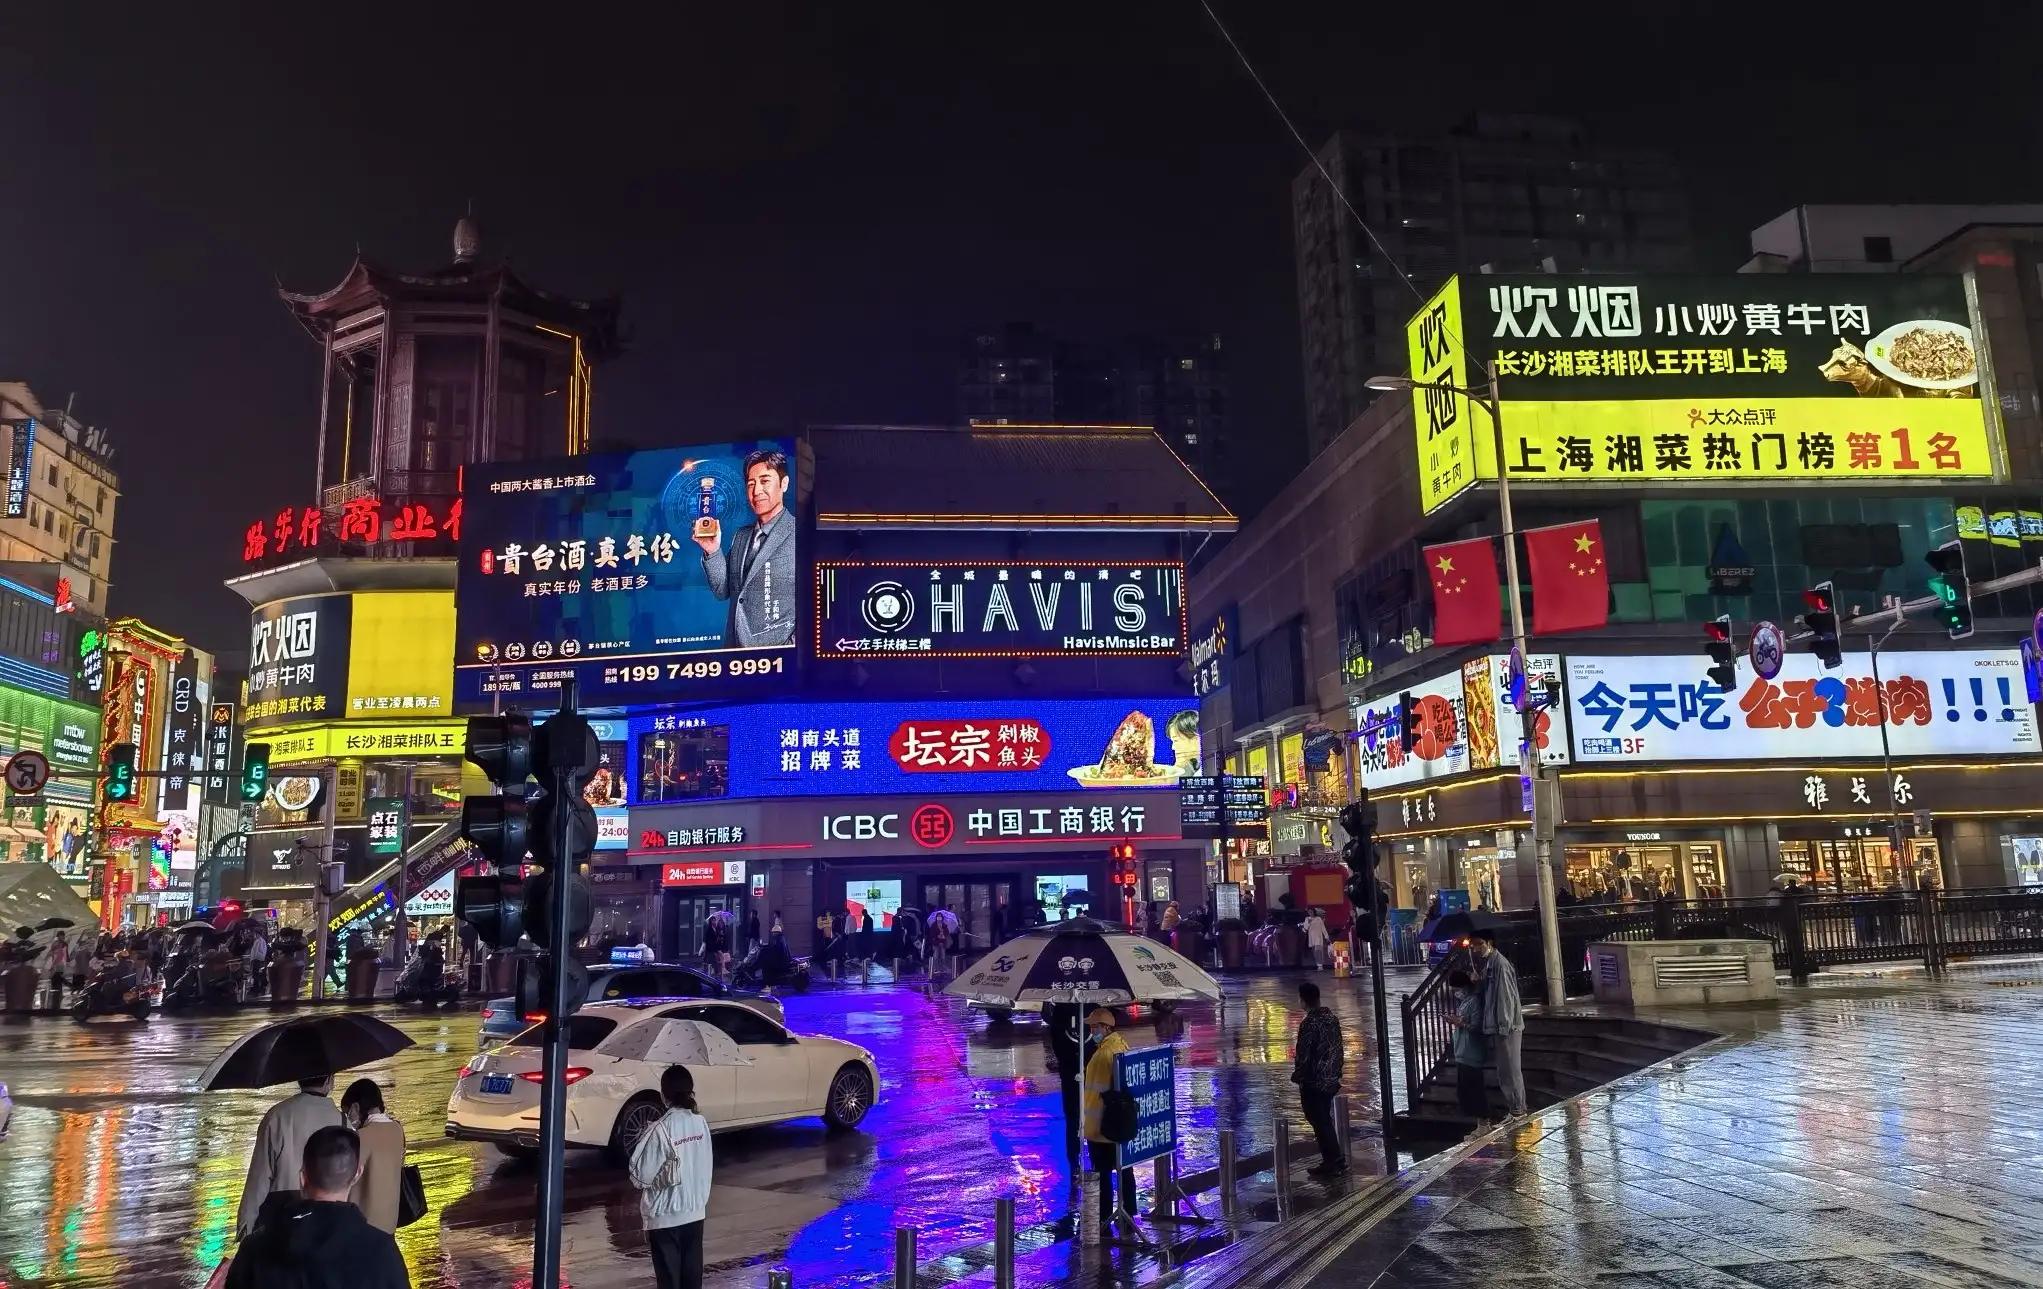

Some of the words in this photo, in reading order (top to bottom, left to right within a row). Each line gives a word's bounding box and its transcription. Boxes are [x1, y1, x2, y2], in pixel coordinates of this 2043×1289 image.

[1489, 285, 1642, 338] 炊烟
[1655, 302, 1872, 336] 小炒黄牛肉
[1495, 347, 1788, 377] 长沙湘菜排队王开到上海
[1707, 407, 1776, 426] 大众点评
[490, 474, 596, 494] 中国两大酱香上市酒企
[524, 580, 581, 597] 真实年份
[591, 575, 649, 592] 老酒更多
[931, 583, 1146, 632] HAVIS
[251, 611, 317, 668] 炊烟
[620, 666, 660, 683] 199
[667, 661, 722, 680] 7499
[729, 657, 784, 677] 9991
[176, 677, 191, 713] CRD
[353, 696, 441, 710] 营业至凌晨两点
[346, 732, 455, 749] 长沙湘菜排队王
[780, 728, 861, 748] 湖南头道
[997, 724, 1041, 744] 剁椒
[901, 724, 992, 767] 坛宗
[1623, 739, 1645, 754] 3F
[780, 749, 861, 772] 招牌菜
[1804, 775, 1913, 810] 雅戈尔
[370, 811, 399, 825] 点石
[823, 814, 899, 841] ICBC
[968, 805, 1146, 838] 中国工商银行
[641, 830, 666, 849] 24h
[667, 826, 744, 847] 自助银行服务
[669, 868, 686, 881] 24h
